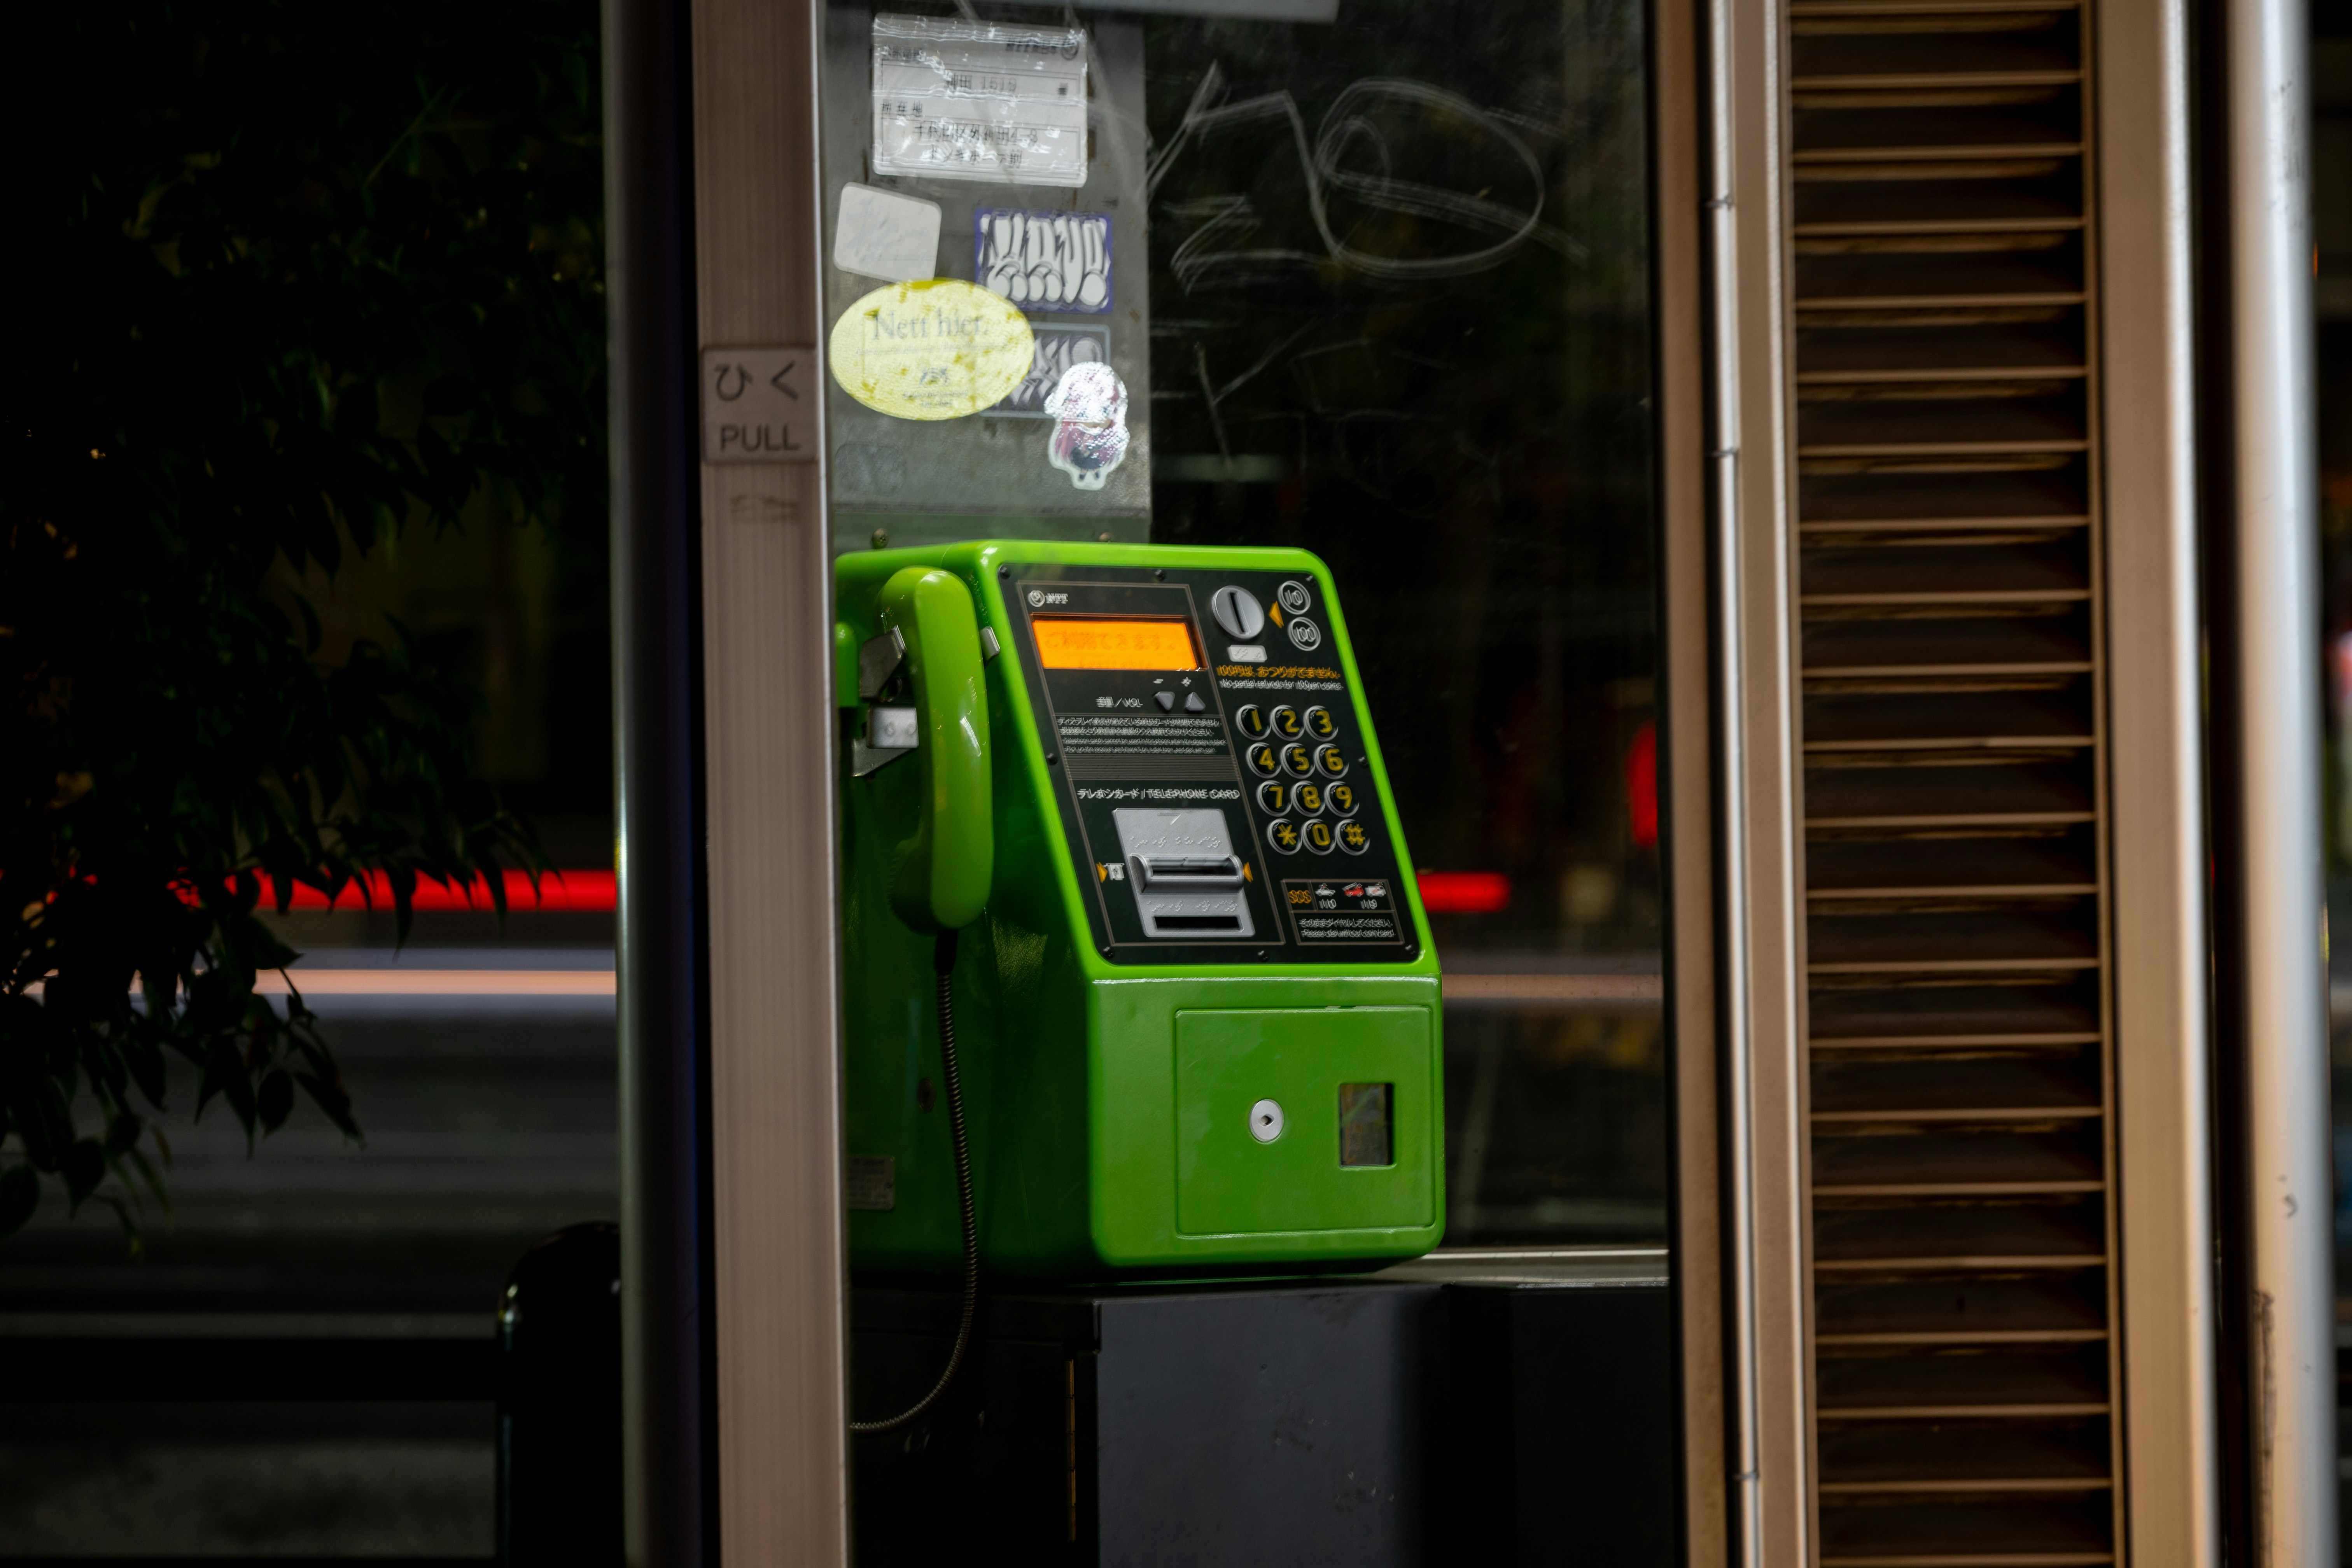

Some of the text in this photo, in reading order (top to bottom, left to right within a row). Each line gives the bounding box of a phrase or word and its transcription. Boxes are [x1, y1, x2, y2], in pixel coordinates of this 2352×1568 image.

[873, 310, 930, 340] Nett
[714, 360, 799, 402] ひく
[721, 424, 800, 452] PULL
[1046, 593, 1068, 605] NTT
[1284, 590, 1304, 606] 10
[1294, 626, 1316, 642] 100
[1220, 679, 1232, 688] No
[1233, 679, 1255, 689] partial
[1255, 680, 1283, 689] refunds
[1283, 680, 1294, 689] for
[1251, 709, 1333, 733] 1 2 3
[1258, 747, 1344, 771] 4 5 6
[1077, 788, 1139, 800] テレホンカード
[1146, 789, 1208, 800] TELEPHONE
[1209, 789, 1240, 800] CARD
[1269, 786, 1353, 810] 7 8 9
[1311, 823, 1331, 846] 0
[1288, 889, 1312, 904] SOS
[1319, 898, 1337, 909] 110
[1360, 898, 1378, 910] 119
[1338, 929, 1362, 937] without
